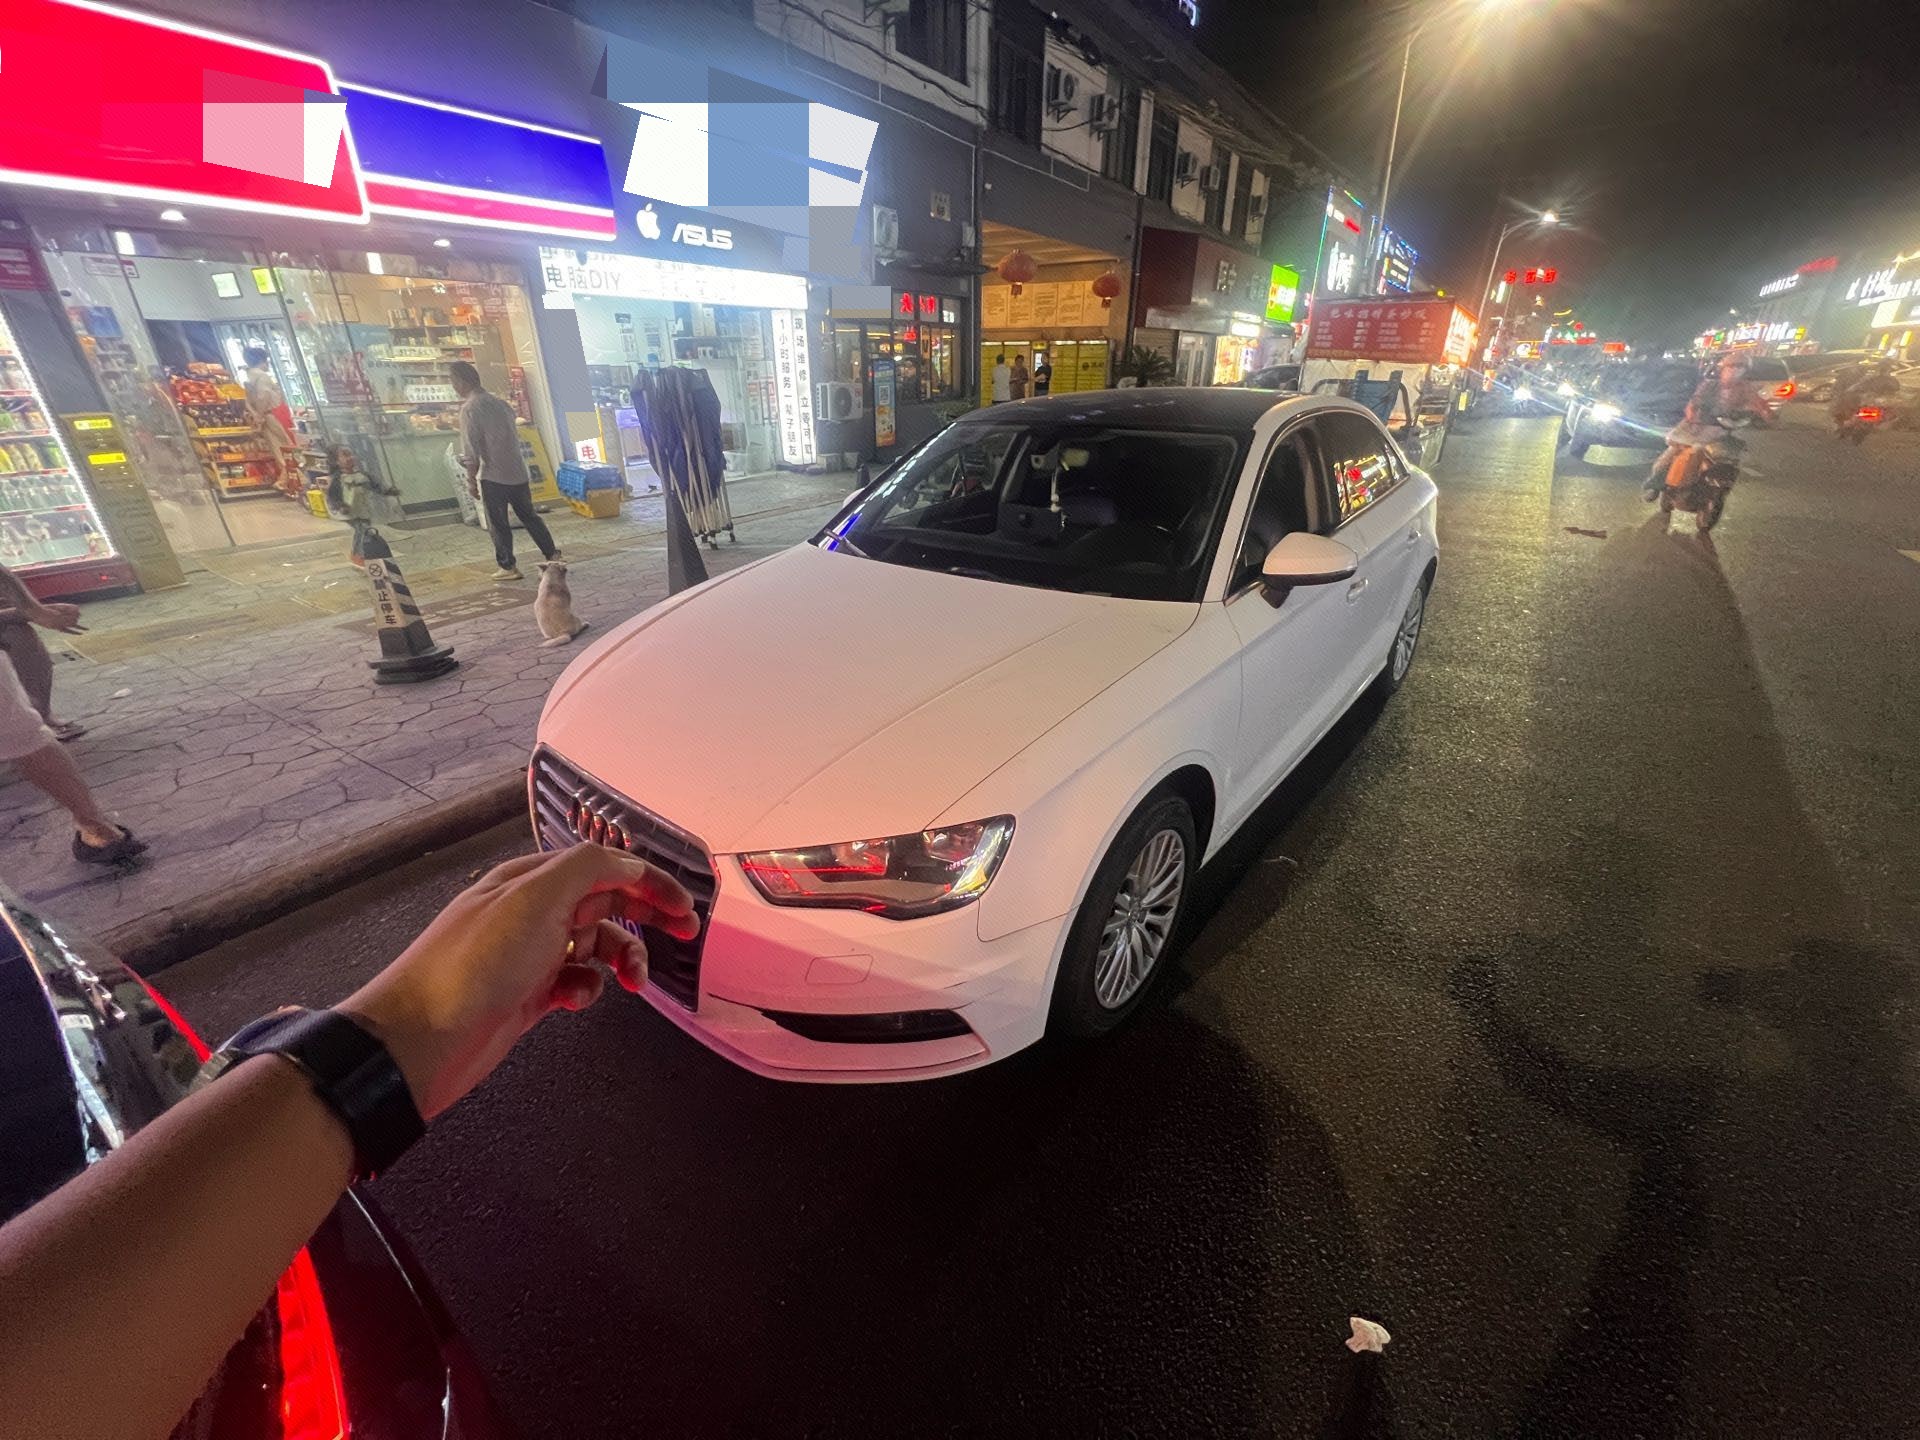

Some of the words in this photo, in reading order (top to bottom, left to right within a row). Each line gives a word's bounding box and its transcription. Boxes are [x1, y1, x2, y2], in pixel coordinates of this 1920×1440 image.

[672, 222, 733, 250] ASUS
[545, 264, 621, 290] 电脑DIY
[581, 445, 597, 460] 电
[373, 578, 397, 625] 禁止停车
